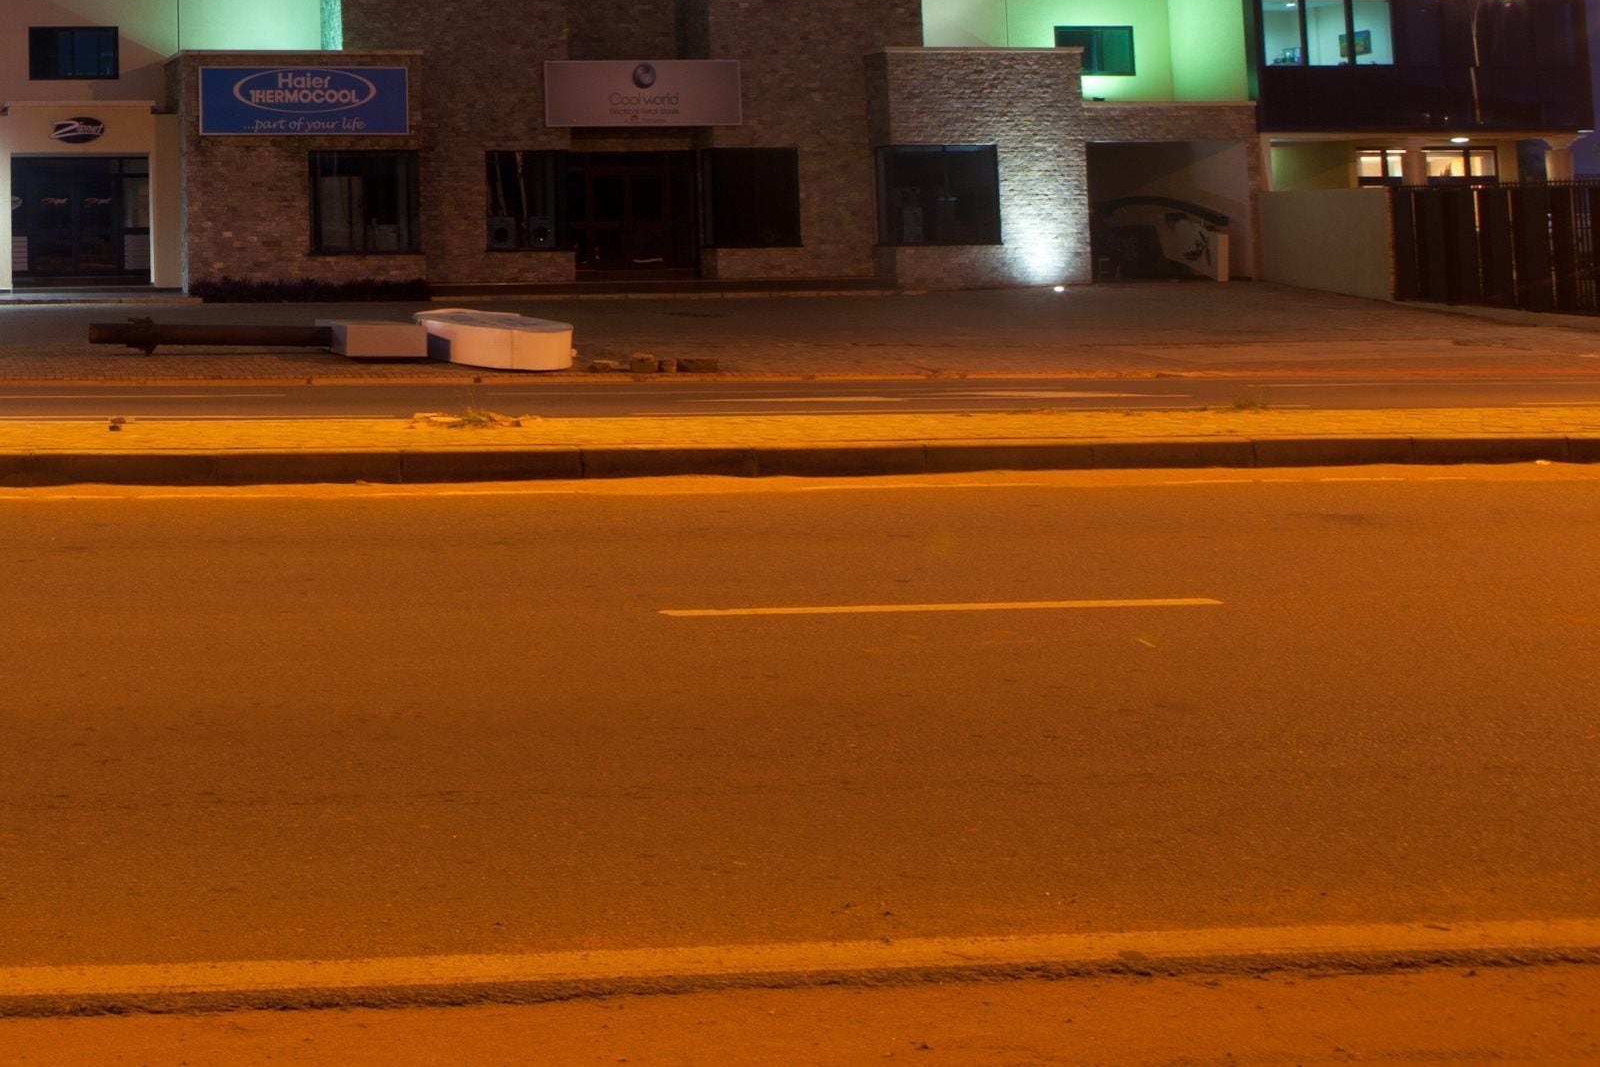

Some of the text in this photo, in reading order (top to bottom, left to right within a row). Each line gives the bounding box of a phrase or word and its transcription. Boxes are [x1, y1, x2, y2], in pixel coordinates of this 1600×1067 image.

[277, 72, 331, 89] Haier
[249, 89, 360, 104] THERMOCOOL
[288, 117, 305, 130] of
[306, 120, 338, 132] your
[342, 117, 368, 130] life
